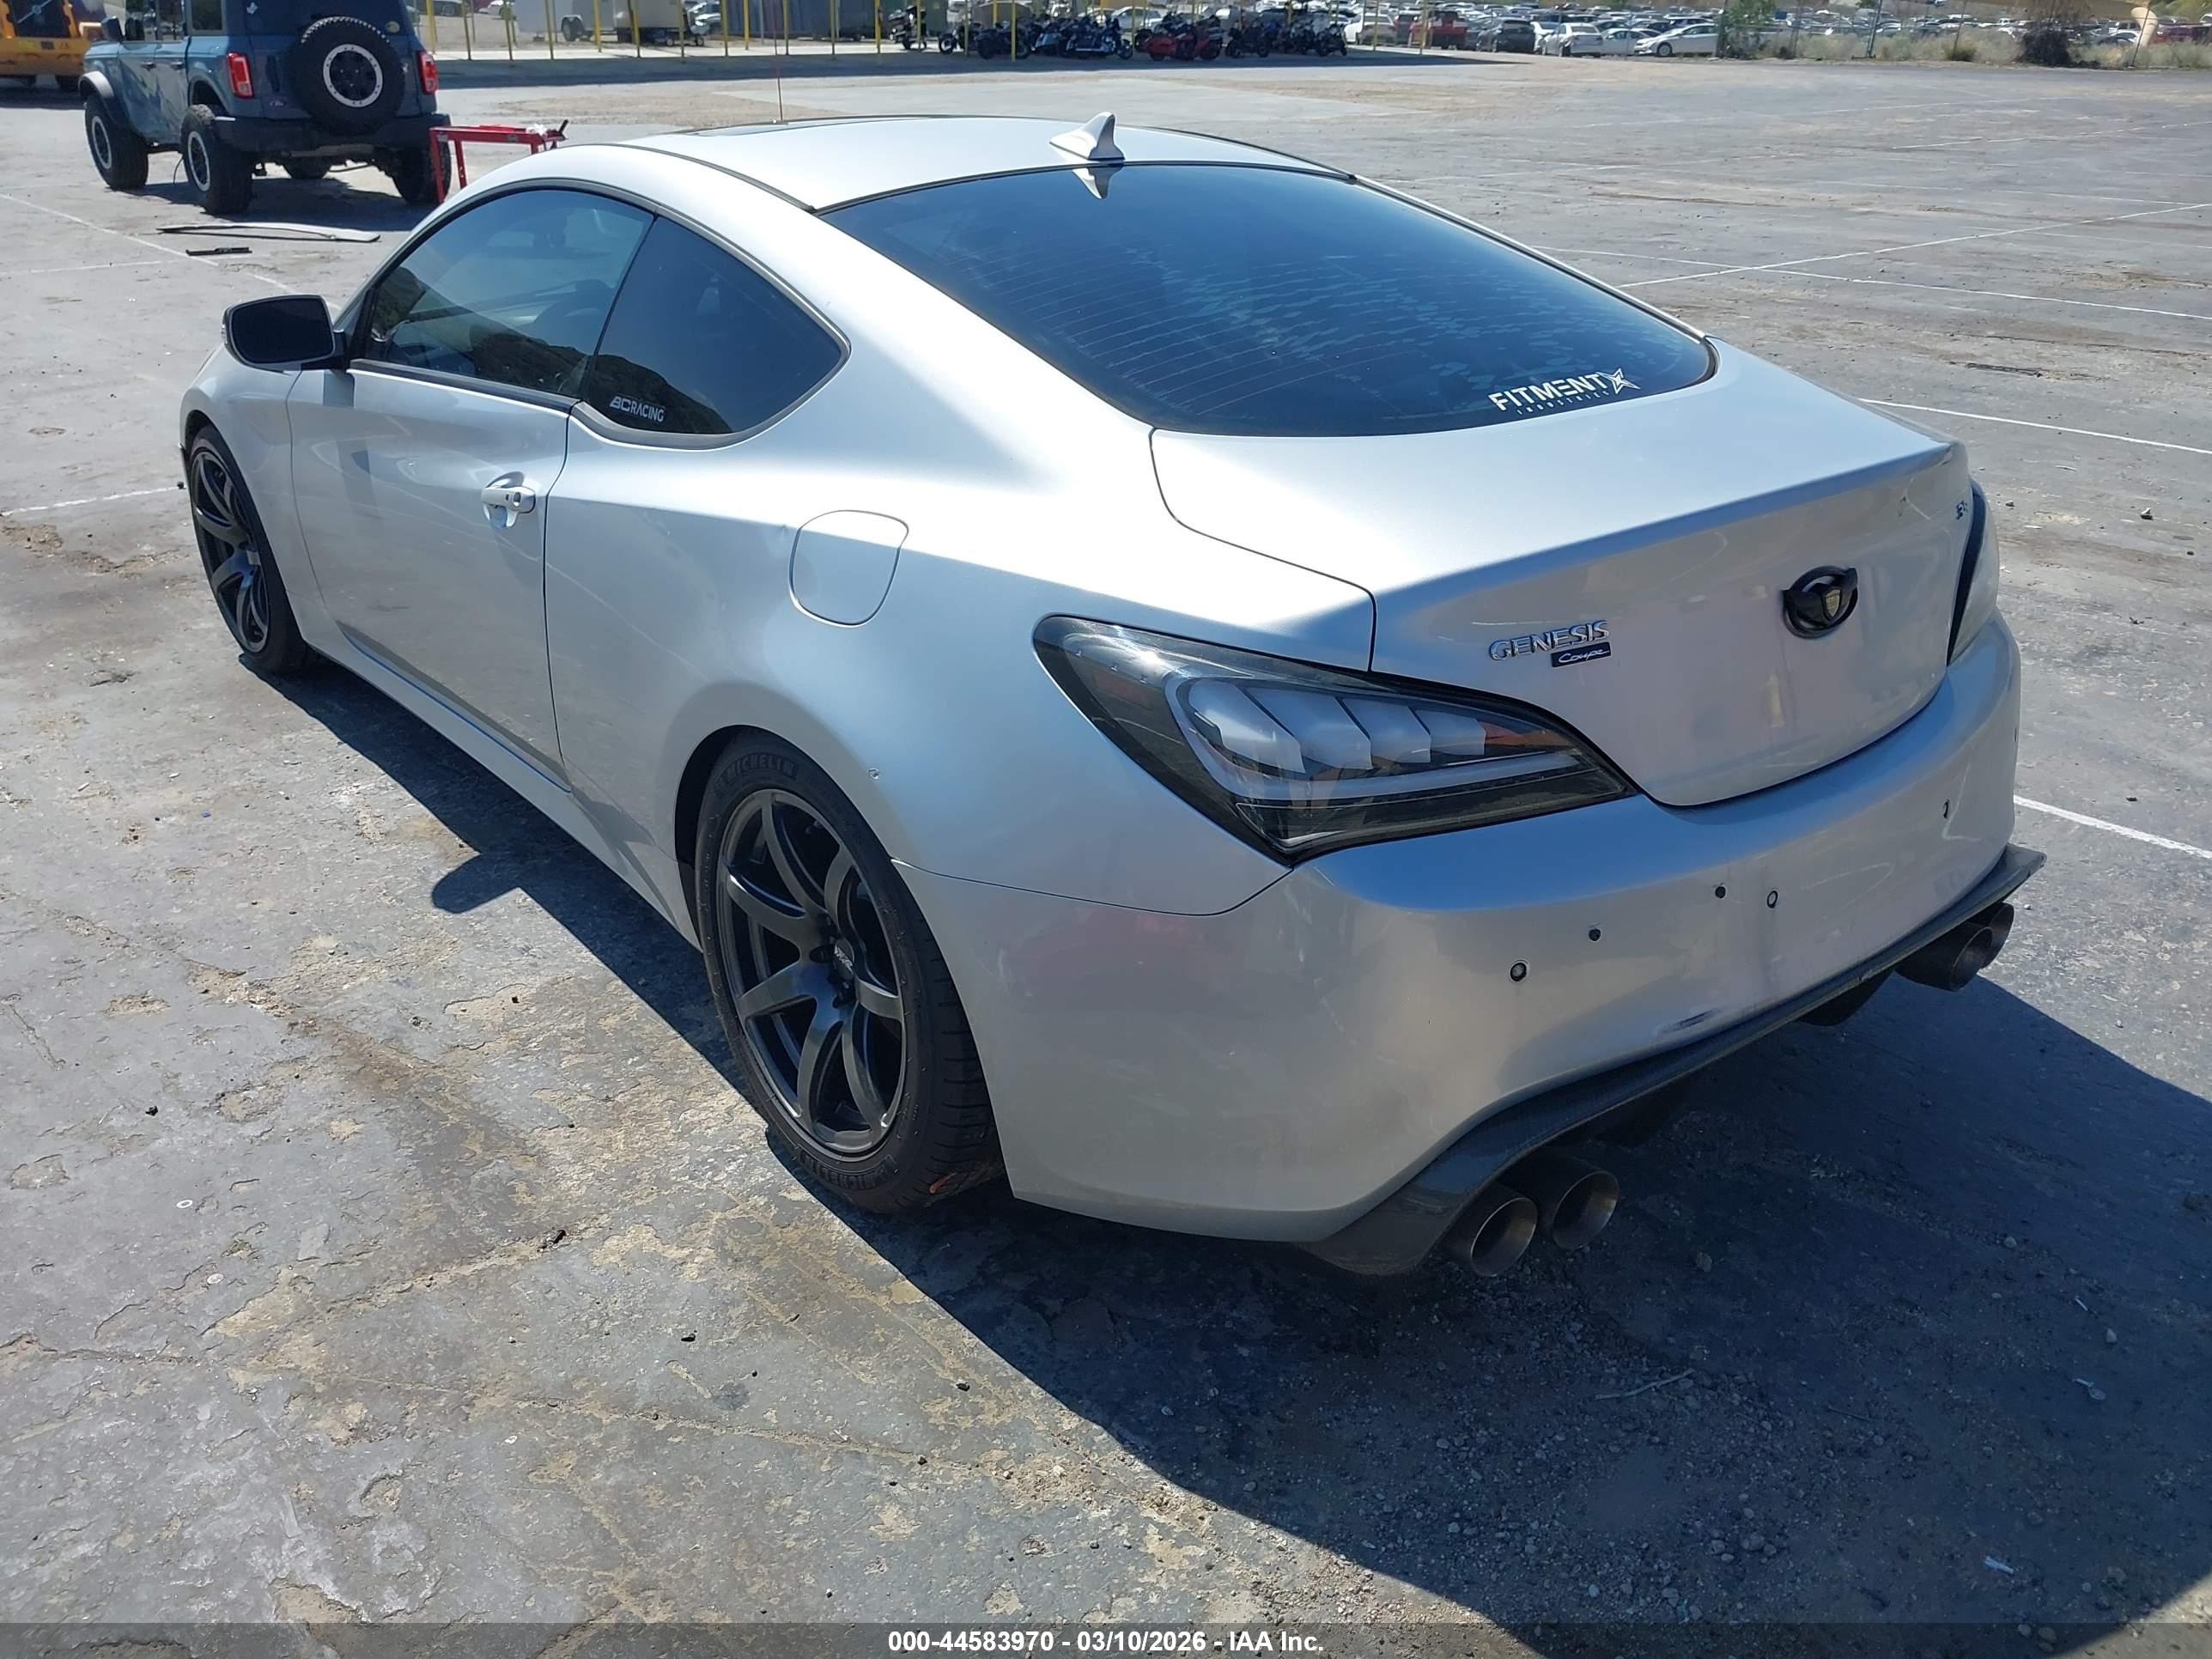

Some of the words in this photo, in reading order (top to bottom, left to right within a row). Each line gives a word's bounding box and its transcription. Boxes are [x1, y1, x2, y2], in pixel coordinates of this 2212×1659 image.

[1488, 373, 1608, 411] FITMENT
[1489, 620, 1610, 661] GENESIS
[1558, 648, 1610, 663] Coupe
